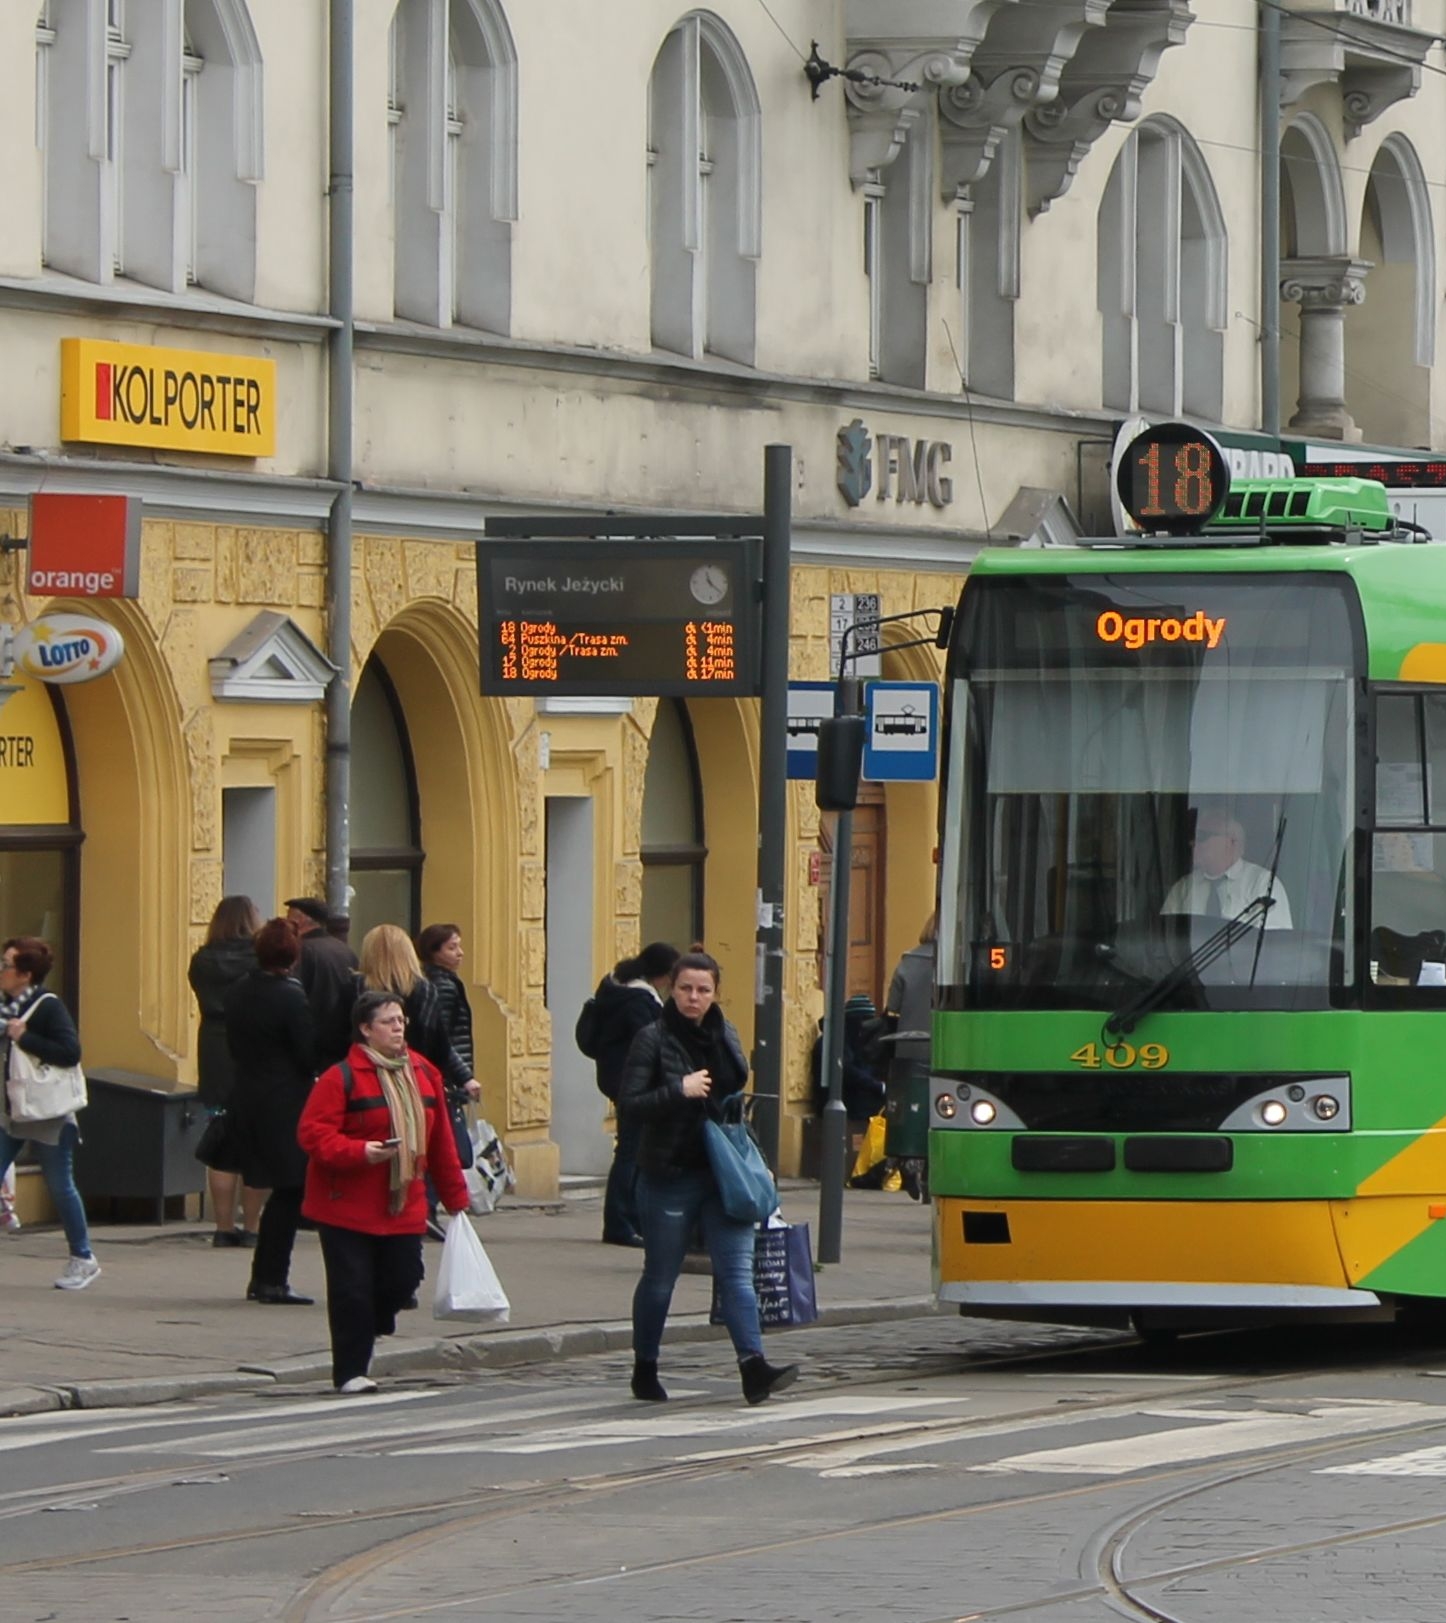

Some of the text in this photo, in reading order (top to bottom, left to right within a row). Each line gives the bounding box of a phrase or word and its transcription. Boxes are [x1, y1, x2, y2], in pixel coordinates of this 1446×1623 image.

[112, 364, 262, 436] KOLPORTER
[876, 433, 953, 508] FMG
[1138, 443, 1212, 515] 18
[31, 570, 115, 594] orange
[504, 575, 624, 595] Rynek Jeżycki
[839, 598, 846, 610] 2
[501, 621, 515, 634] 18
[521, 621, 556, 636] Ogrody
[521, 633, 567, 645] Puszkina
[609, 635, 630, 645] zm.
[706, 633, 733, 645] 4min
[1097, 610, 1227, 649] Ogrody
[38, 638, 90, 668] LOTTO
[509, 644, 517, 657] 2
[521, 644, 557, 658] Ogrody
[599, 646, 619, 657] zm.
[706, 644, 734, 657] 4min
[502, 656, 734, 670] 17 Ogrody 11min
[502, 667, 735, 681] 18 Ogrody 17min
[1069, 1042, 1170, 1070] 409
